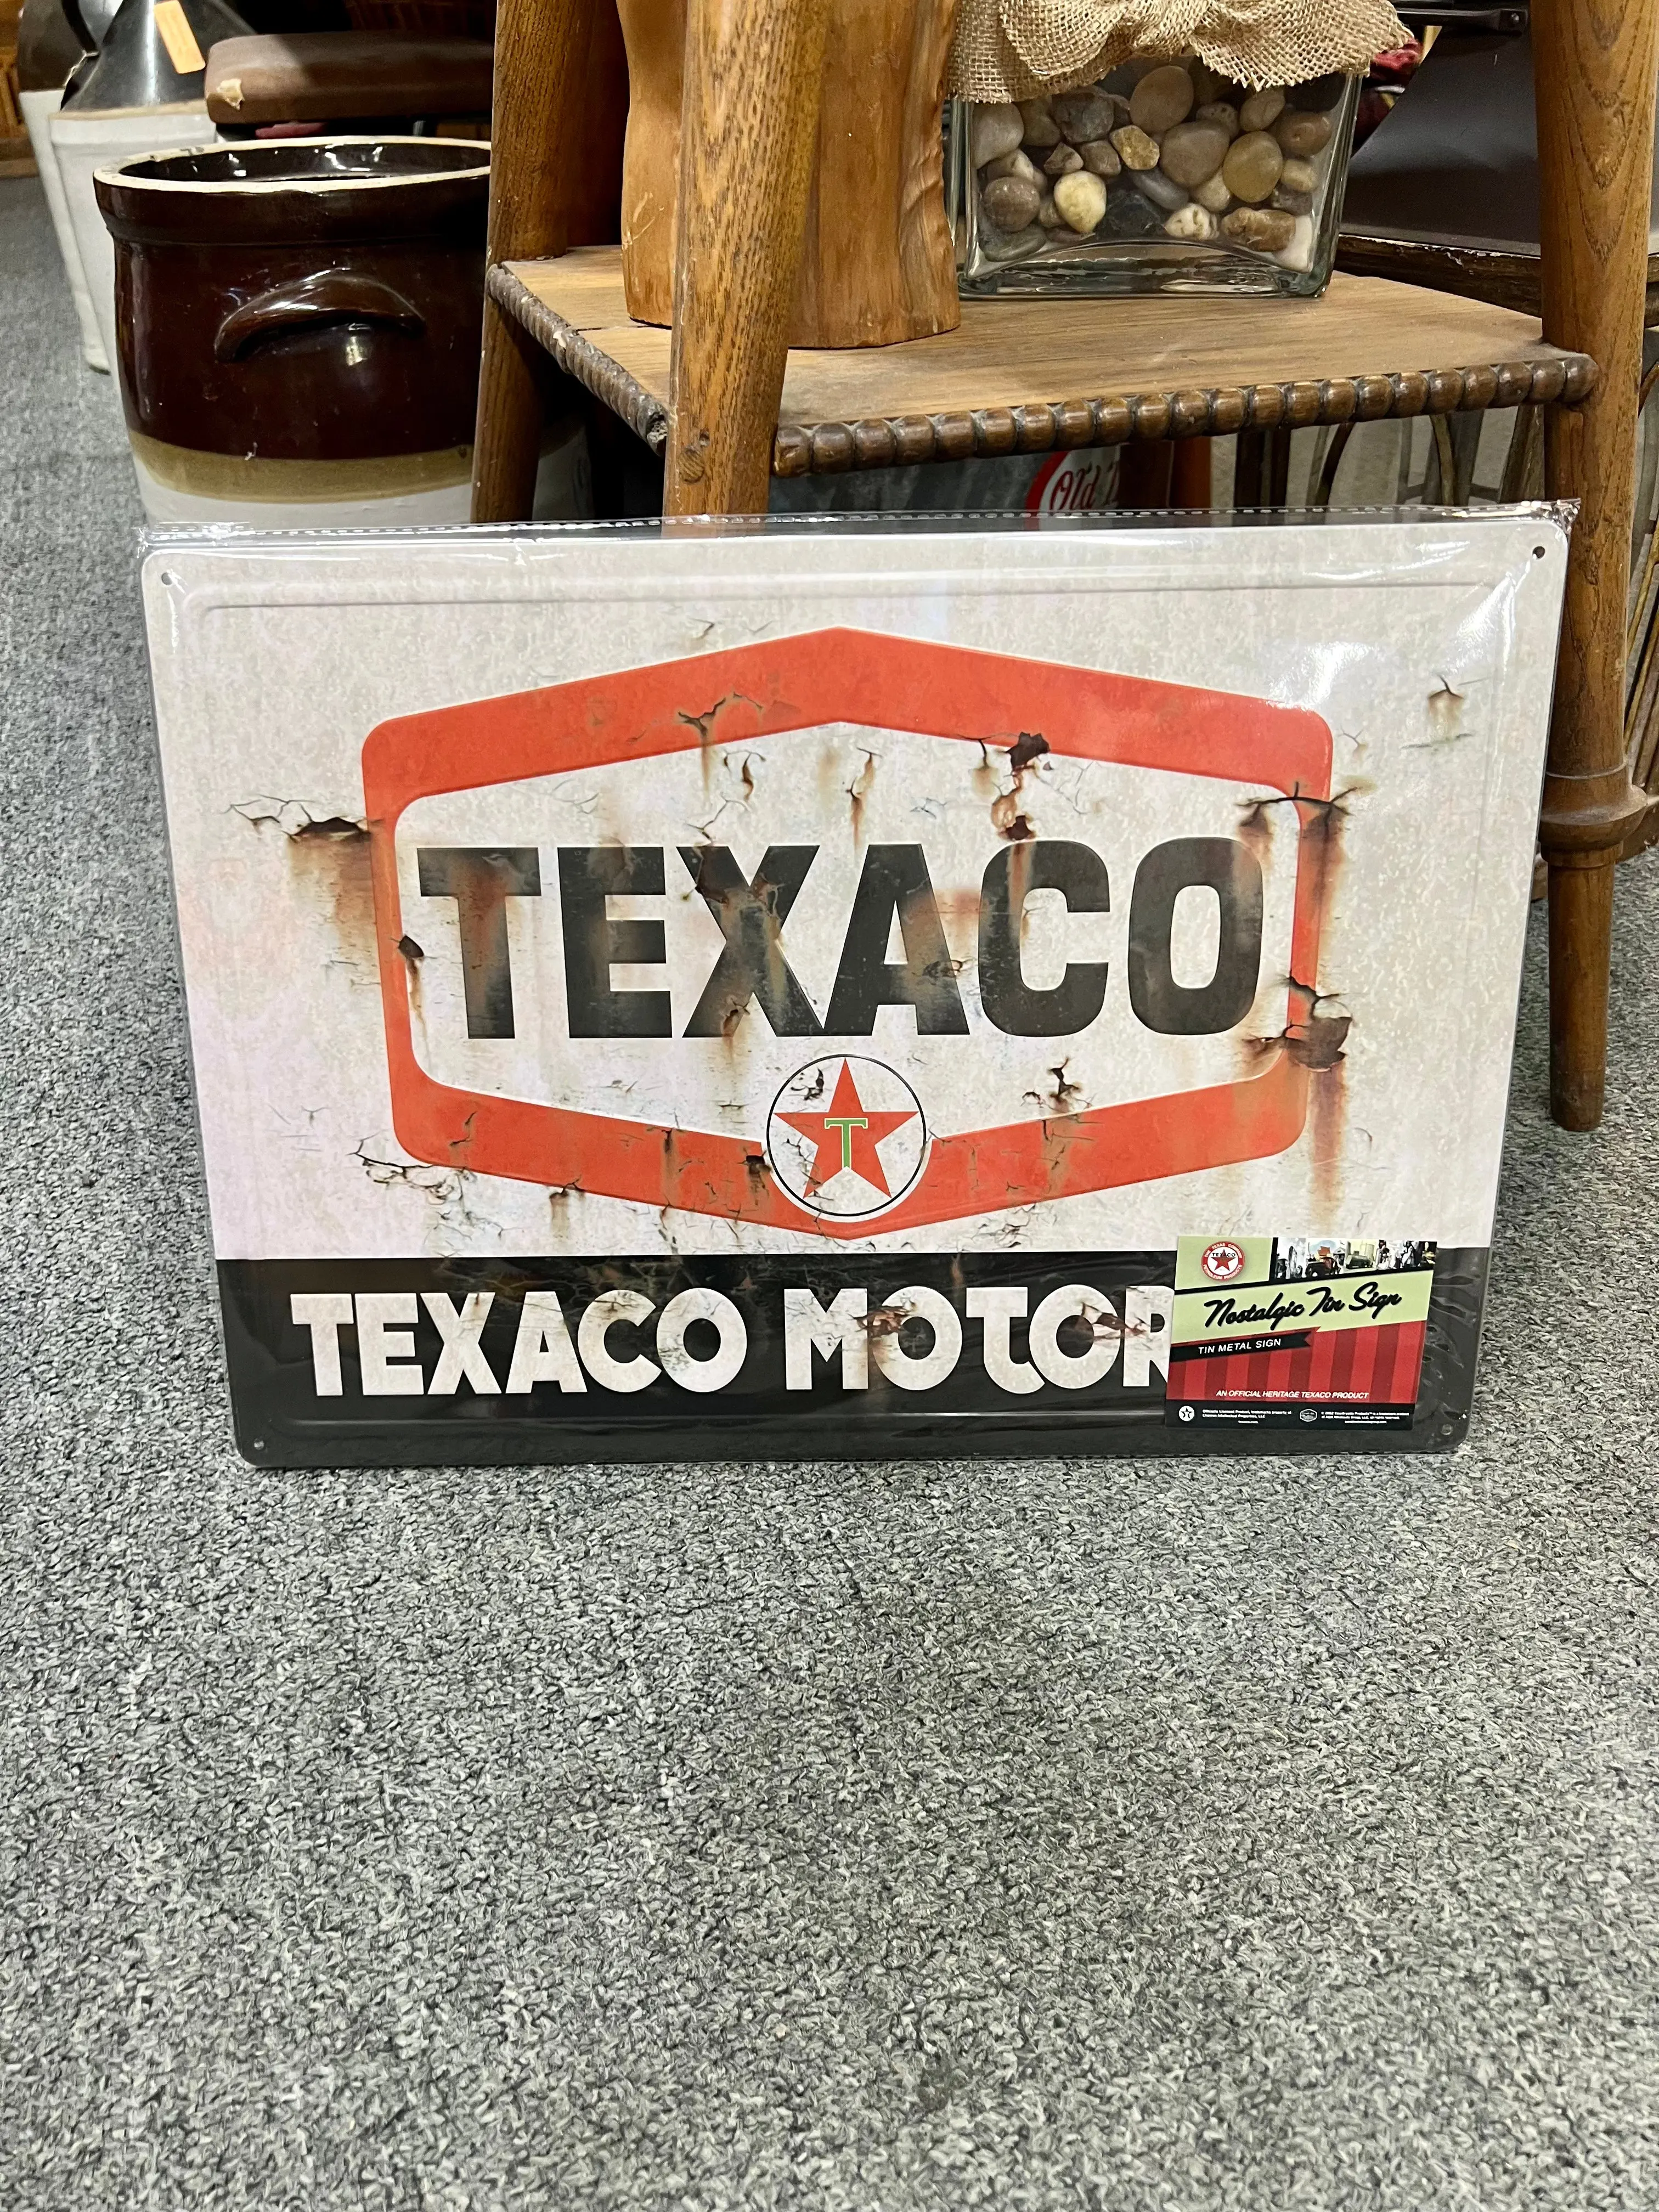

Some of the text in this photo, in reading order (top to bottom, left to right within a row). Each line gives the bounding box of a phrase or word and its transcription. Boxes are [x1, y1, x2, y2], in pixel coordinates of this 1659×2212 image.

[1049, 465, 1102, 510] Old
[417, 837, 1263, 1039] TEXACO
[825, 1118, 868, 1170] T
[1204, 1282, 1402, 1330] Nostalgic Tin Sign
[290, 1284, 1175, 1396] TEXACO MOTOR
[1198, 1338, 1281, 1354] TIN METAL SIGN
